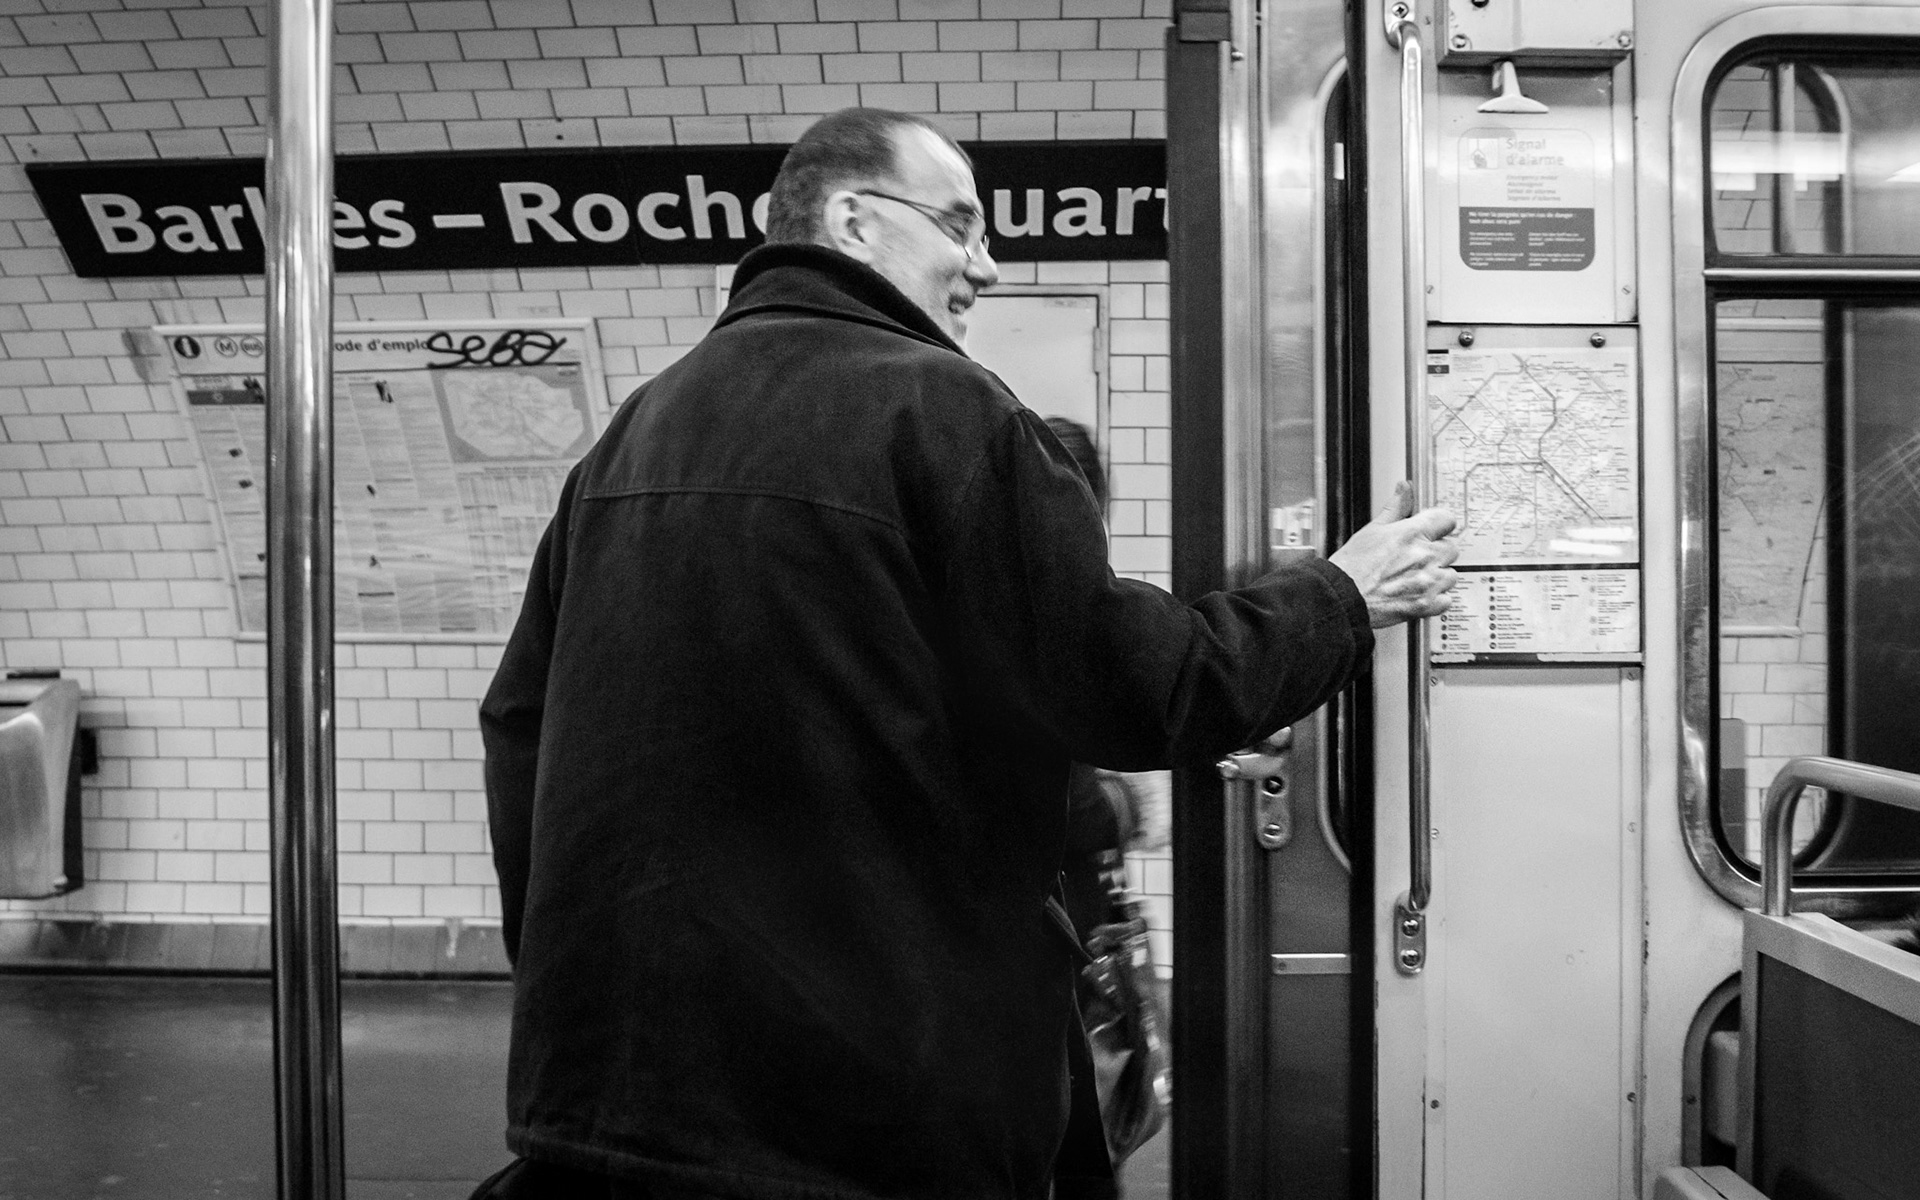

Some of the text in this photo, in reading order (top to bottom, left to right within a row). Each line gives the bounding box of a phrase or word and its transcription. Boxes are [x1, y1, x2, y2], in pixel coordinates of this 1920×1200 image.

[1506, 138, 1546, 152] Signal
[1506, 153, 1565, 166] d'alarme
[334, 339, 362, 352] ode
[367, 338, 429, 353] d'emplo
